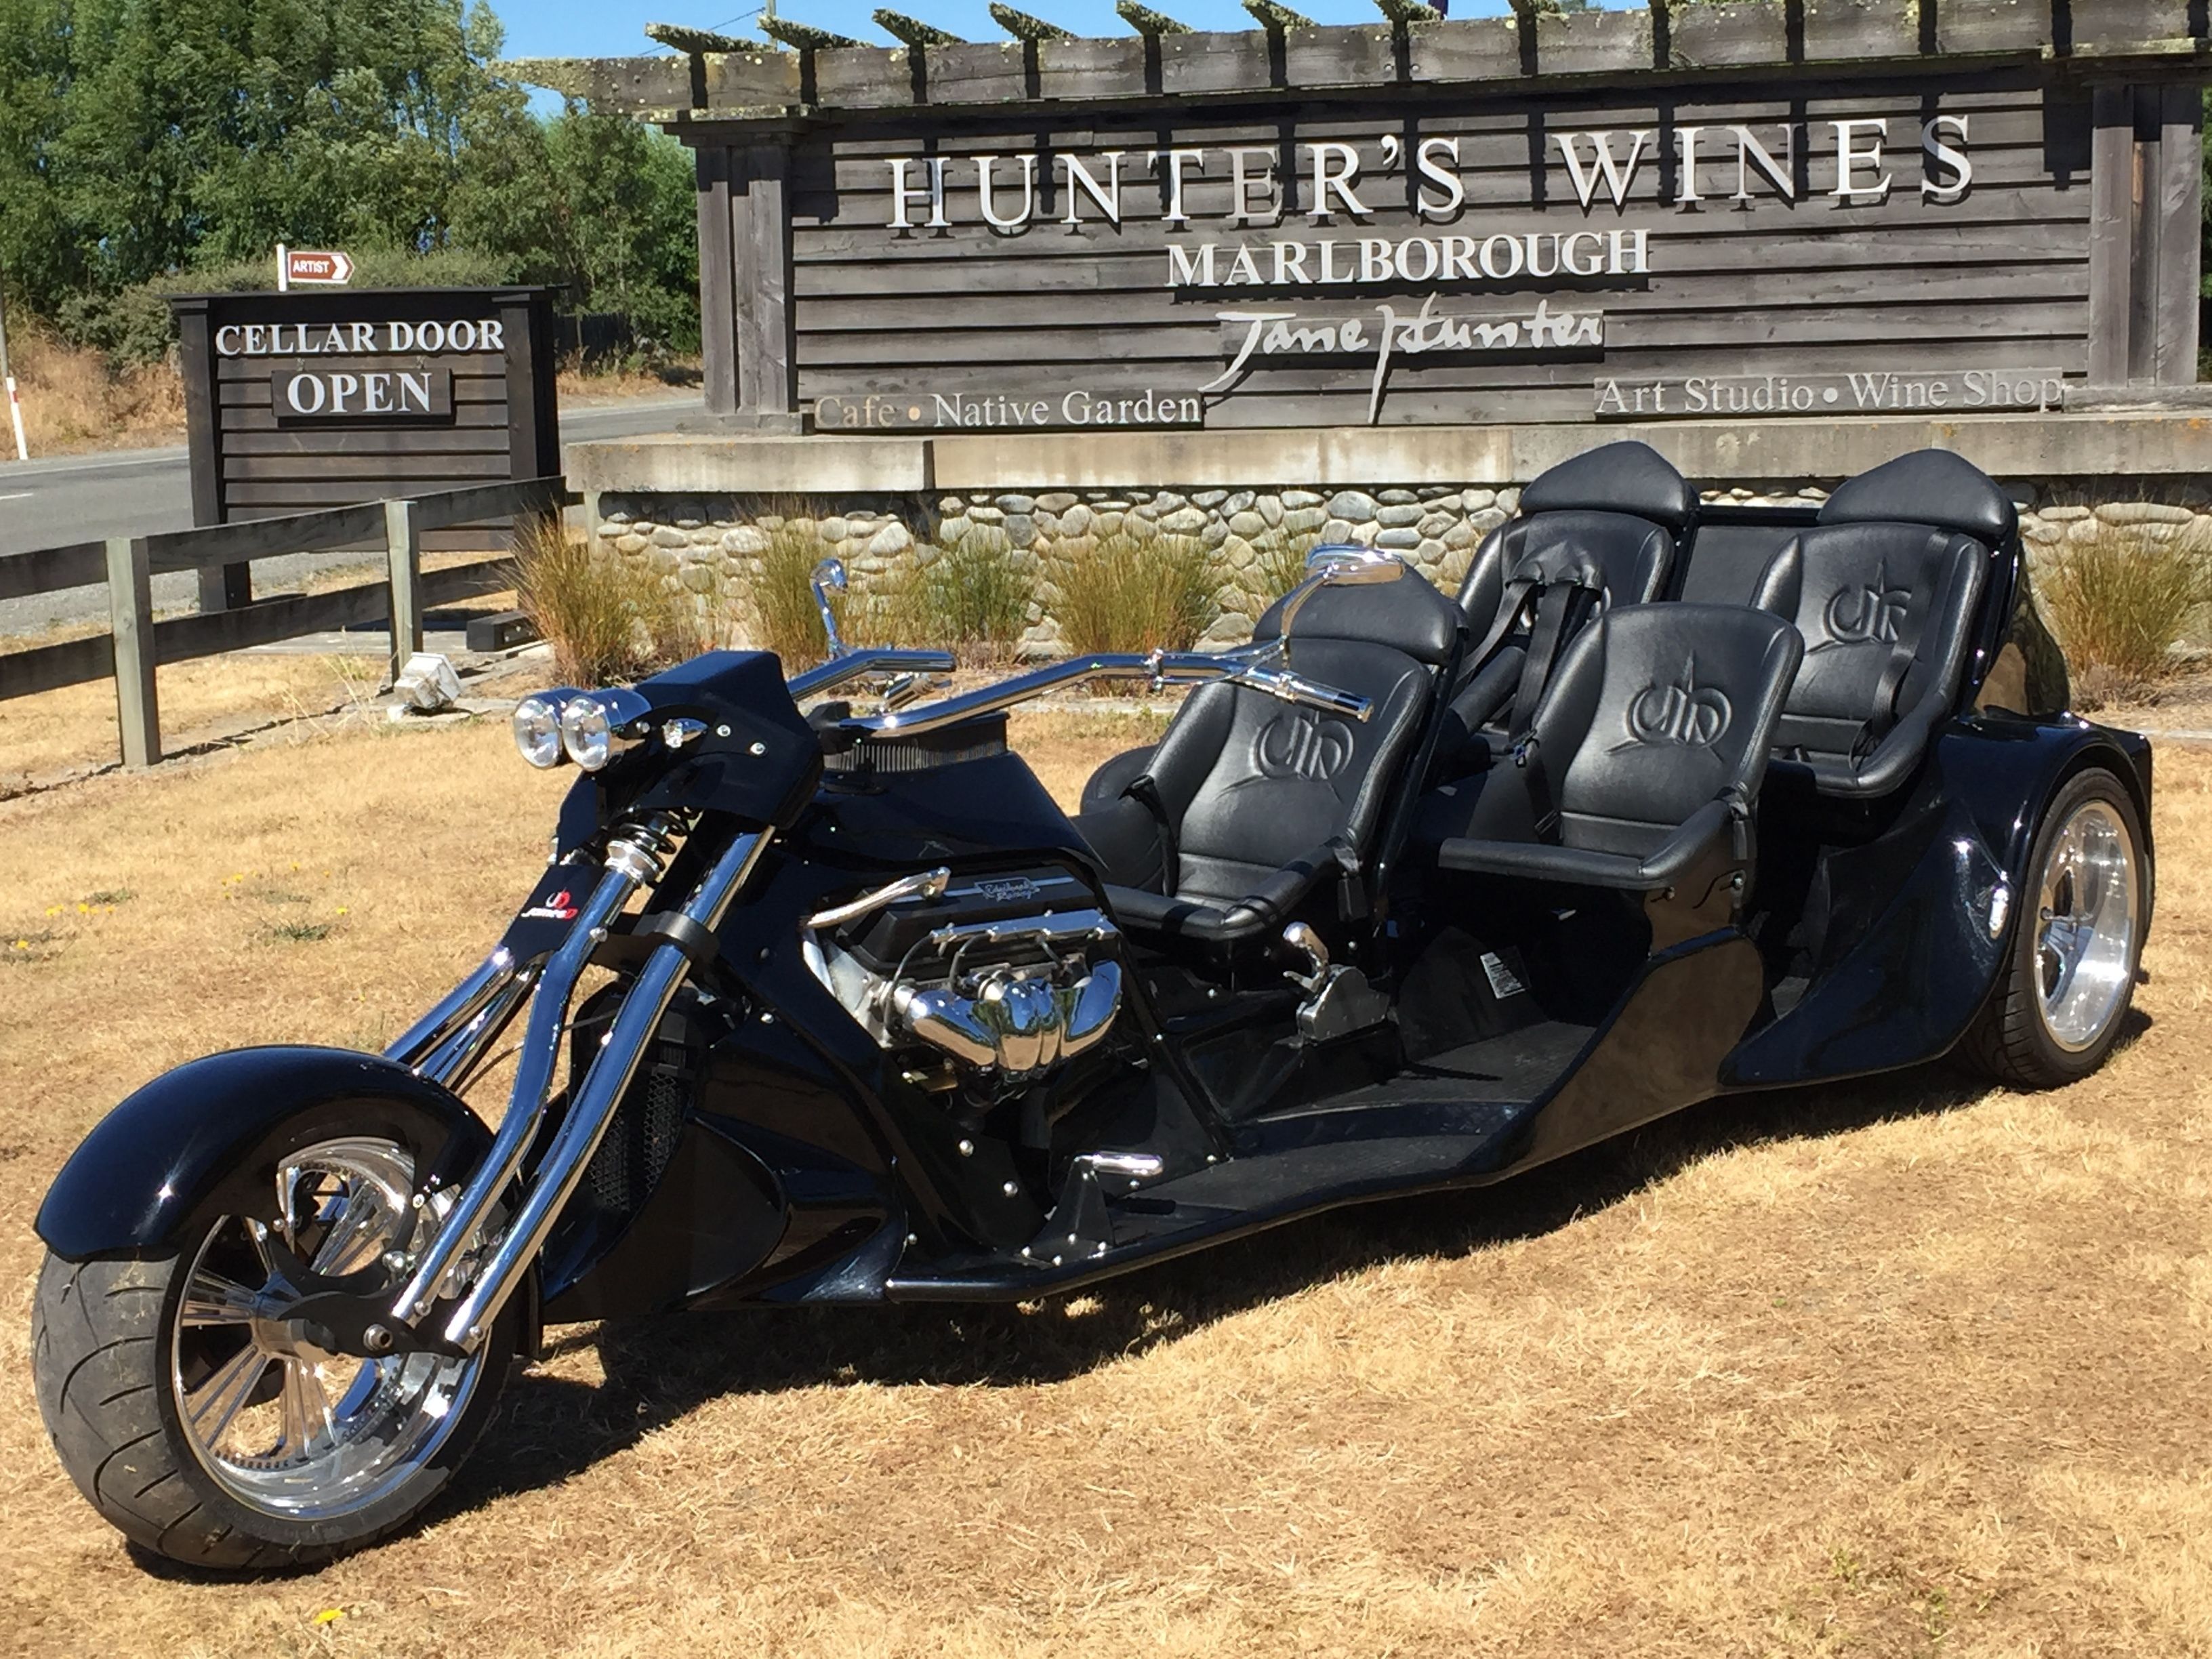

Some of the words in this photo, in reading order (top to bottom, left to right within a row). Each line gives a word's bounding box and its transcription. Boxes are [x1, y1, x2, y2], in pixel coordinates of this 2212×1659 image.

[885, 135, 1467, 228] HUNTER'S
[1553, 114, 1972, 208] WINES
[293, 259, 329, 274] ARTIST
[1164, 226, 1650, 287] MARLBOROUGH
[216, 323, 376, 356] CELLAR
[387, 319, 505, 351] DOOR
[1198, 311, 1368, 393] Jane
[287, 372, 432, 413] OPEN
[815, 396, 895, 428] Cafe
[931, 393, 1049, 426] Native
[1061, 390, 1202, 424] Garden
[1595, 381, 1665, 414] Art
[1684, 377, 1813, 412] Studio
[1844, 372, 1948, 409] Wine
[1962, 370, 2063, 412] Shop
